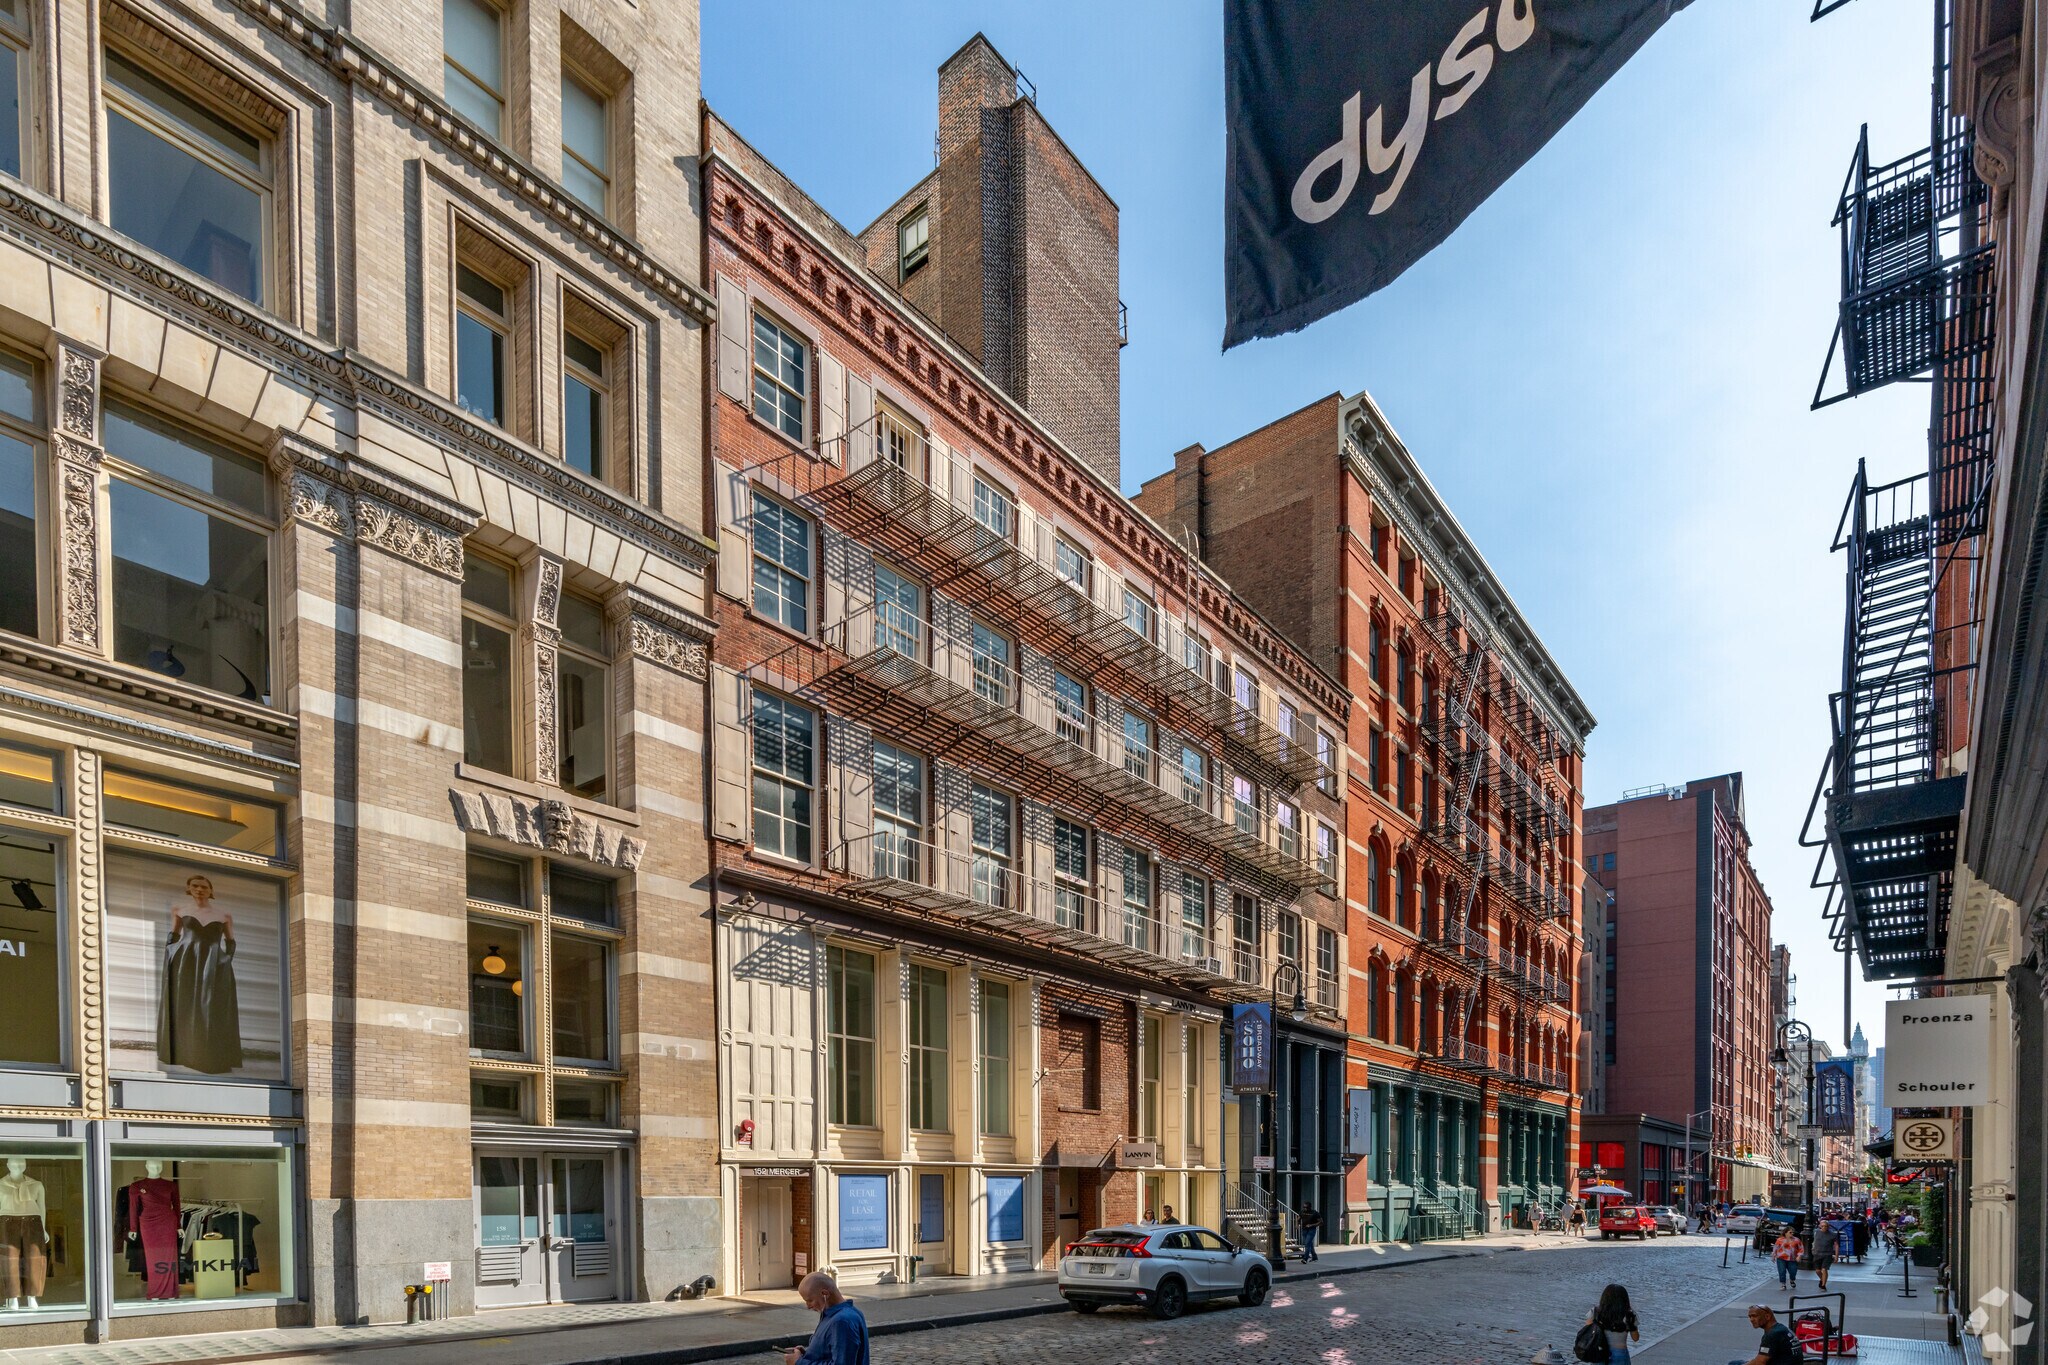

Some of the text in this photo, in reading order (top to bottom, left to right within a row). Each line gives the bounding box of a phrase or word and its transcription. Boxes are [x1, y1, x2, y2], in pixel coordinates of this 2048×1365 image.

[1171, 999, 1197, 1012] LANVIN
[1902, 1013, 1974, 1025] Proenza
[1897, 1081, 1976, 1093] Schouler
[753, 1167, 801, 1176] 152 MERCER
[849, 1189, 877, 1198] RETAIL
[851, 1206, 876, 1215] LEASE
[154, 1258, 259, 1274] SIMKHAI
